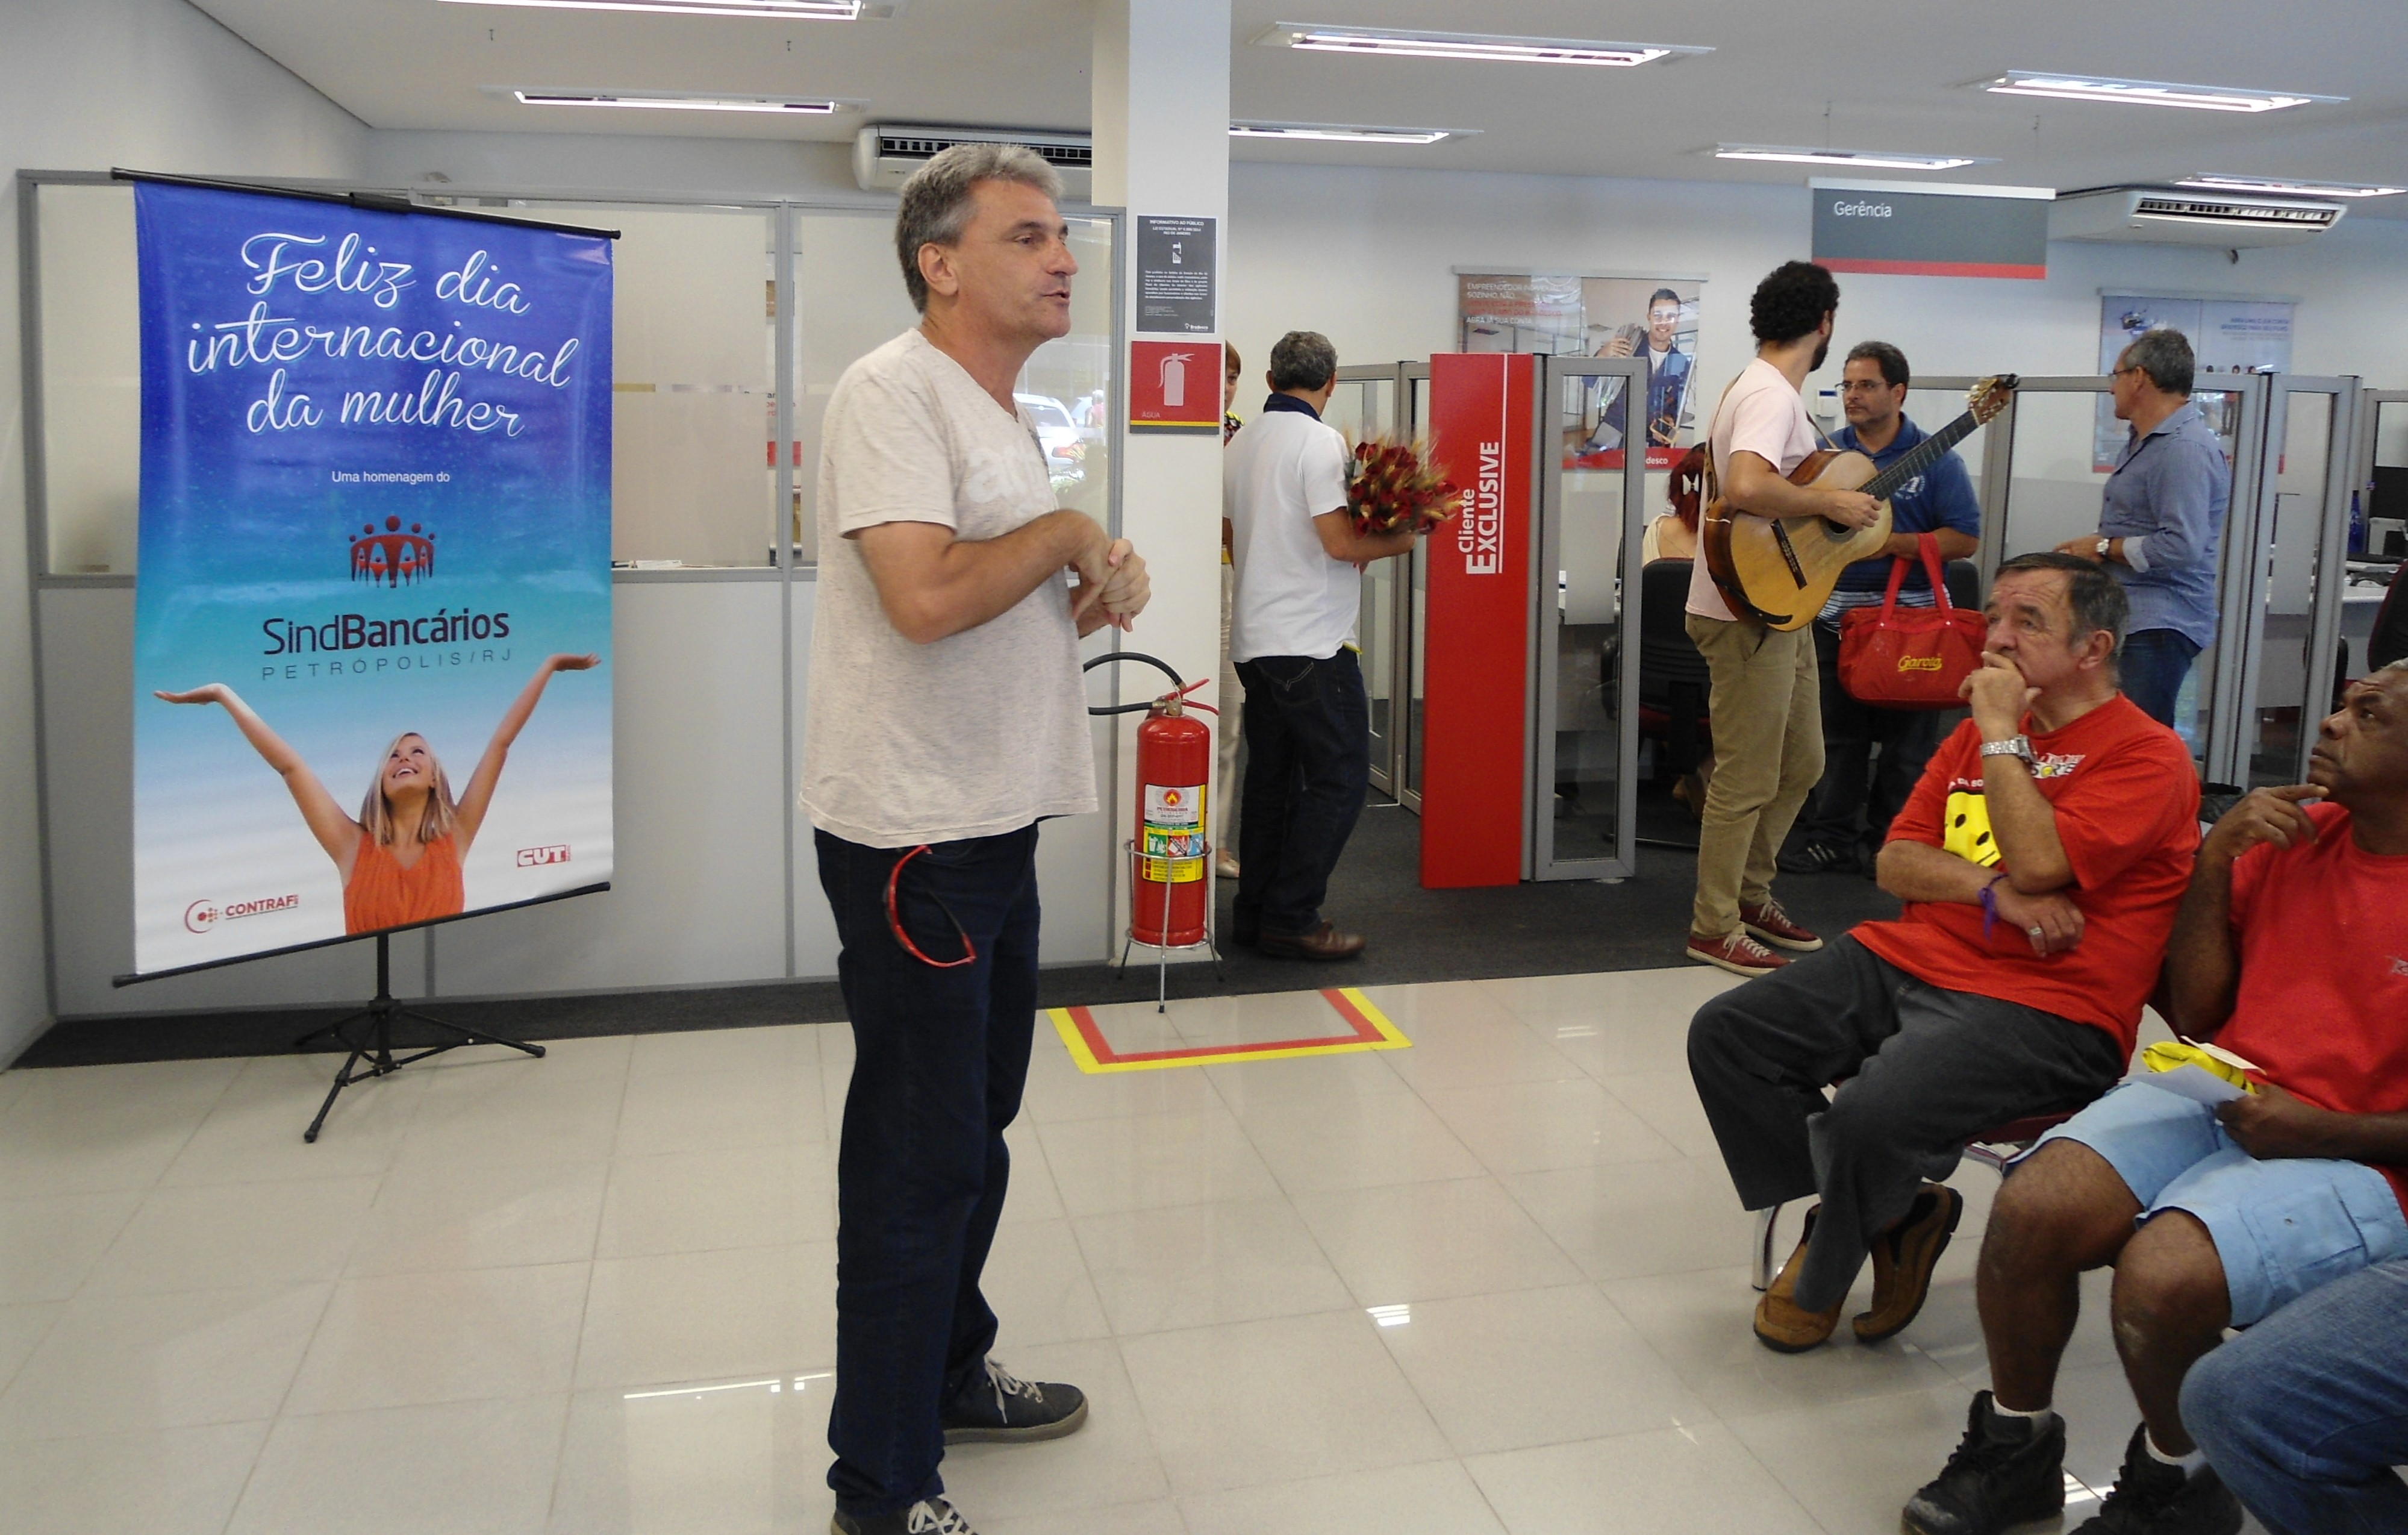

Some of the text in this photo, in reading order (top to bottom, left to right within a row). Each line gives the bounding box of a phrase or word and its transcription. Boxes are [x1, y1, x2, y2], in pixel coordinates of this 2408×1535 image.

[1834, 200, 1892, 217] Gerência
[242, 232, 530, 313] Feliz dia
[188, 301, 579, 387] internacional
[248, 369, 525, 437] da mulher
[332, 470, 450, 486] Uma homenagem do
[1458, 489, 1475, 553] Cliente
[1466, 442, 1499, 574] EXCLUSIVE
[263, 608, 510, 655] SindBancários
[518, 846, 565, 866] CUT
[225, 894, 294, 916] CONTRAF
